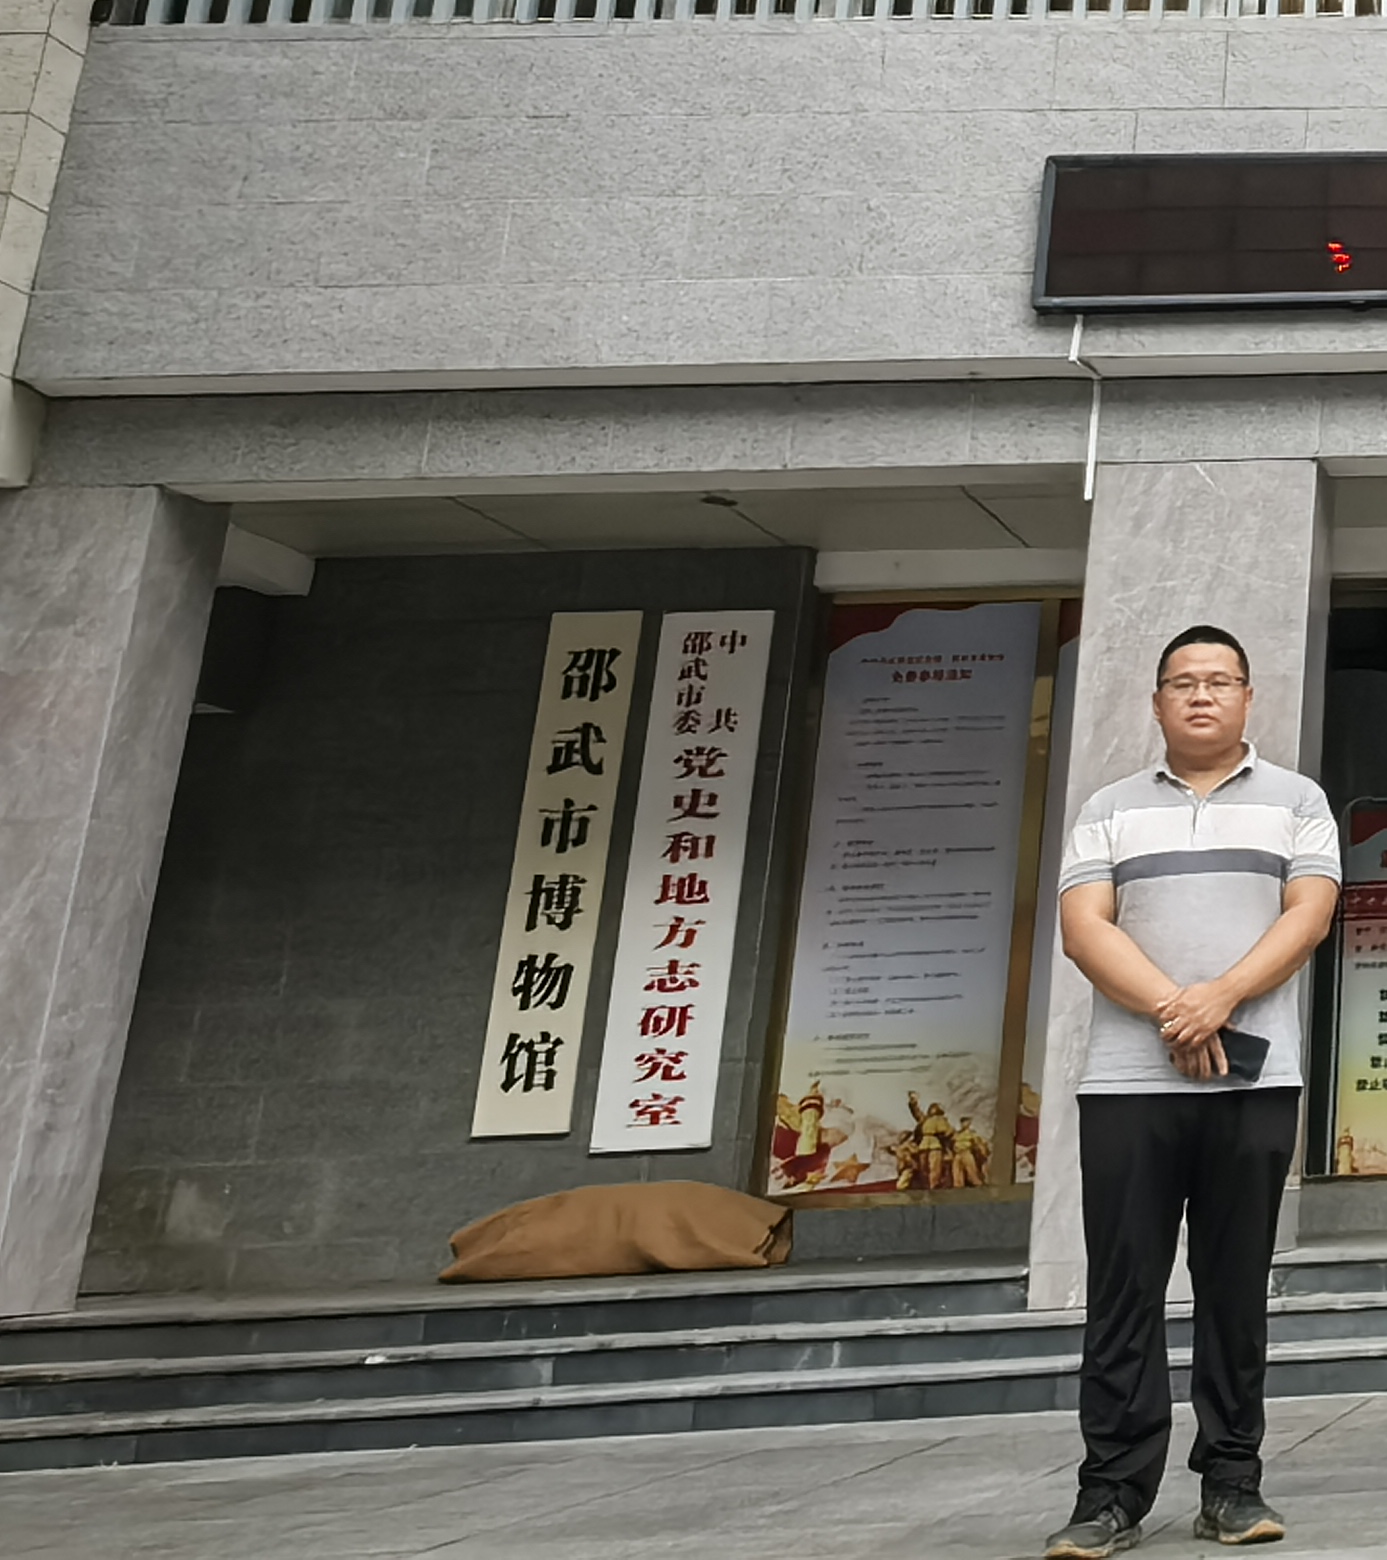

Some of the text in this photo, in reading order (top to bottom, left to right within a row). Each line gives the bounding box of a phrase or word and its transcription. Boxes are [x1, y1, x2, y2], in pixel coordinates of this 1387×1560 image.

[500, 646, 623, 1094] 邵武市博物馆
[626, 745, 728, 1129] 党史和地方志研究室
